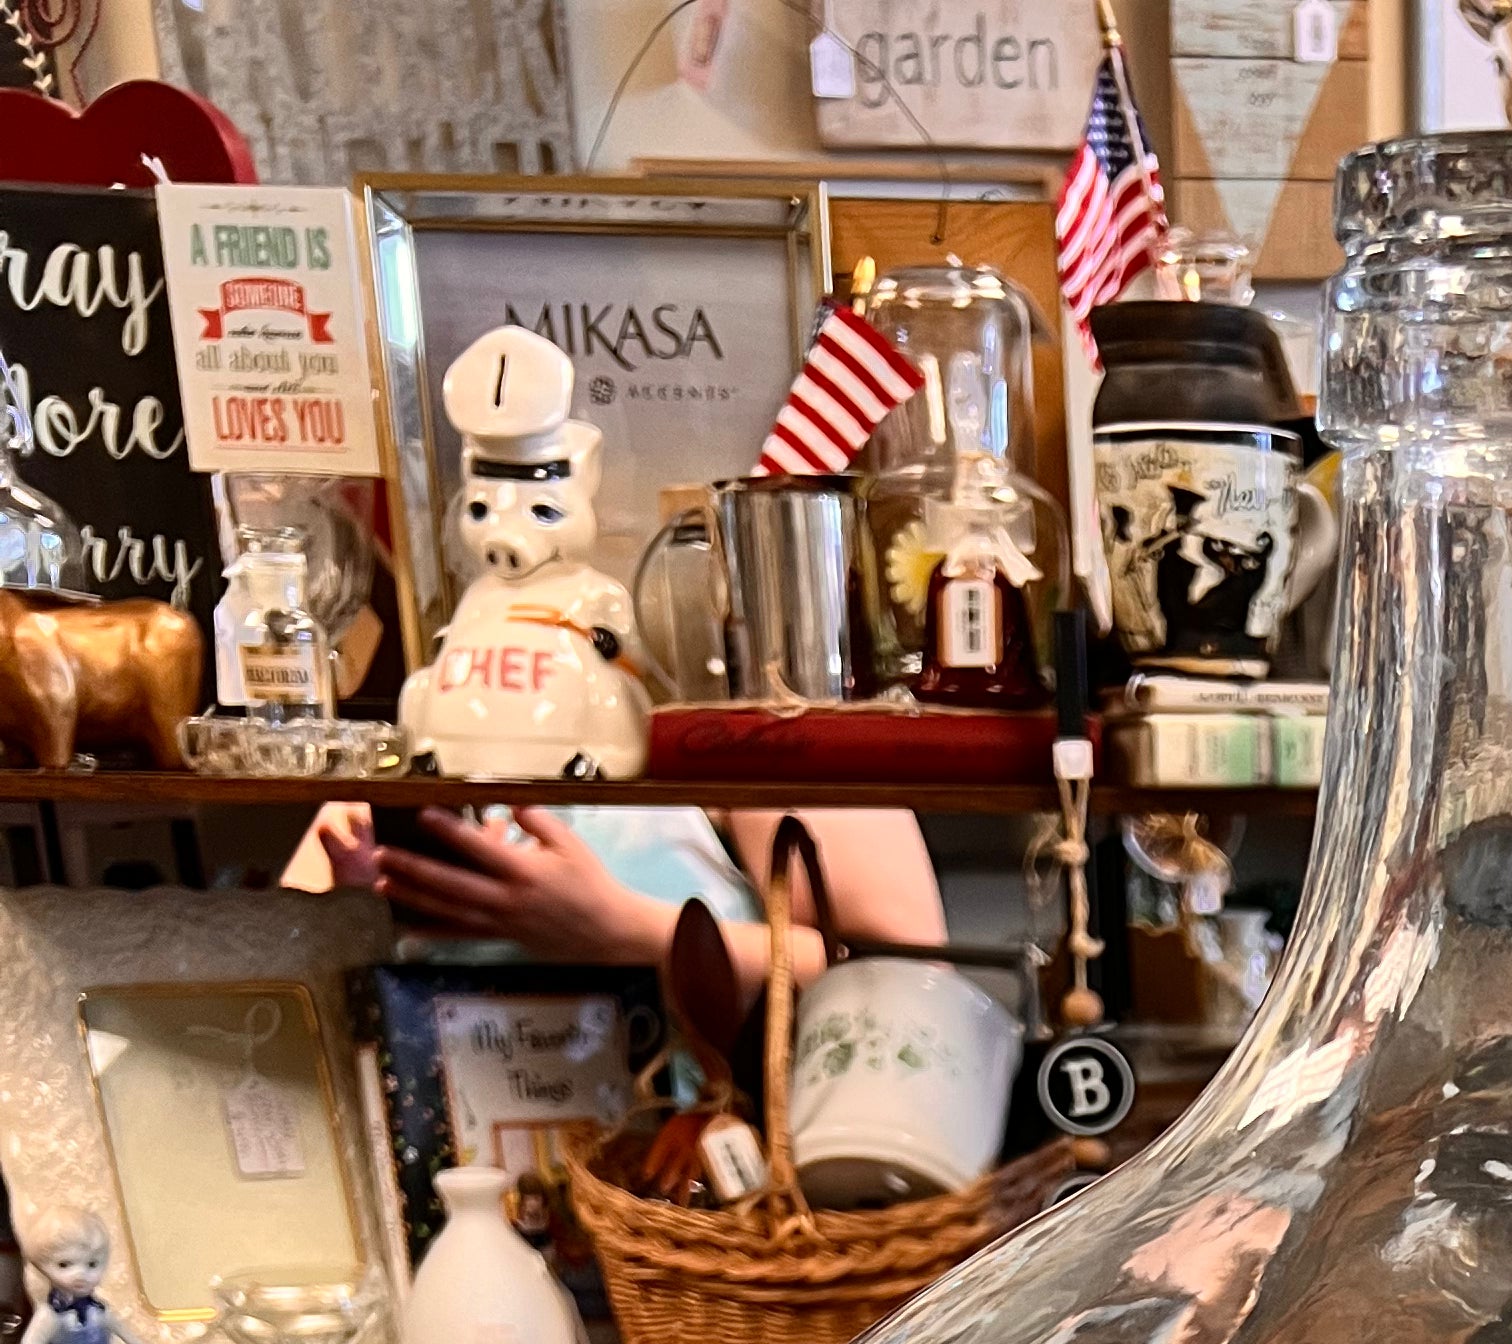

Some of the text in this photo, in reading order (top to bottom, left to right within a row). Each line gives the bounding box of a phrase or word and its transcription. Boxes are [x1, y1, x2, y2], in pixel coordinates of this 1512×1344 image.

[856, 12, 1059, 108] garden
[189, 223, 331, 270] A FRIEND IS
[0, 231, 163, 355] ray
[505, 302, 724, 372] MIKASA
[10, 362, 184, 459] ore
[212, 396, 346, 444] LOVES YOU
[439, 647, 558, 694] CHEF
[1060, 1057, 1111, 1117] B
